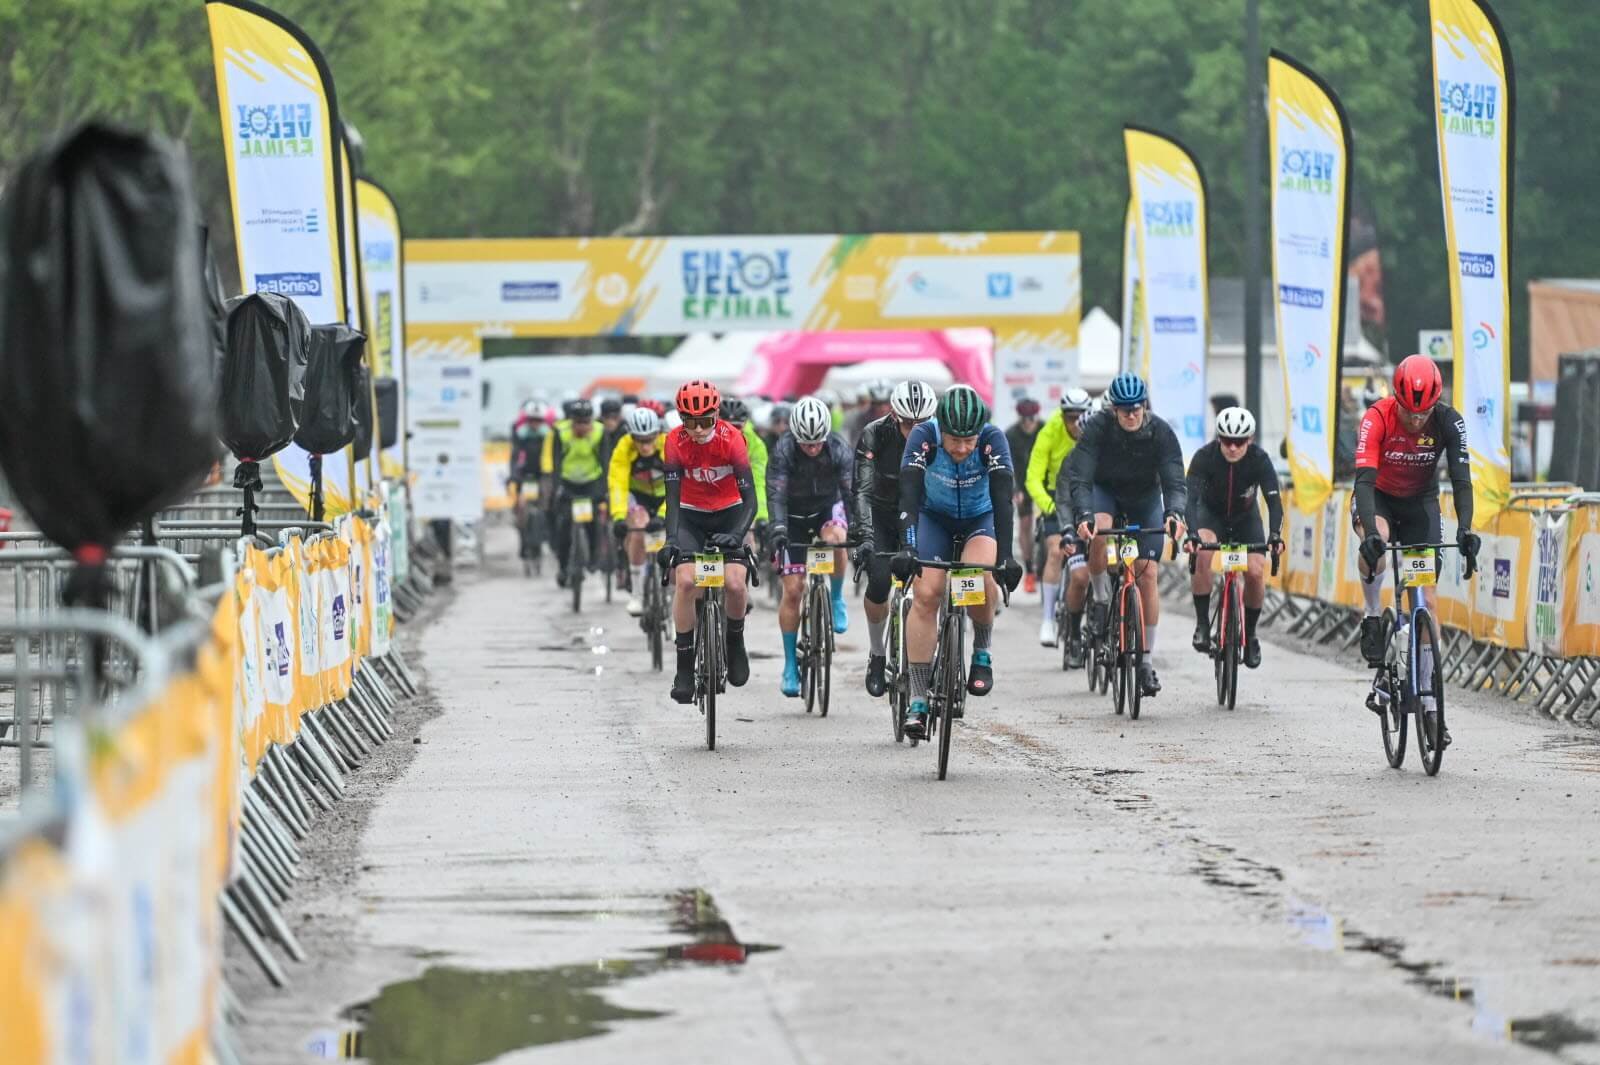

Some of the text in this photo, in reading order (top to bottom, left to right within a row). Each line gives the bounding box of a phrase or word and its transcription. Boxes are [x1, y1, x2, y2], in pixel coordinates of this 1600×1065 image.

[682, 250, 789, 274] ENJOY
[684, 272, 789, 294] VELOS
[682, 295, 793, 318] EPINAL
[1228, 553, 1240, 562] 62
[703, 564, 715, 572] 94
[1411, 560, 1426, 569] 66
[960, 579, 975, 588] 36
